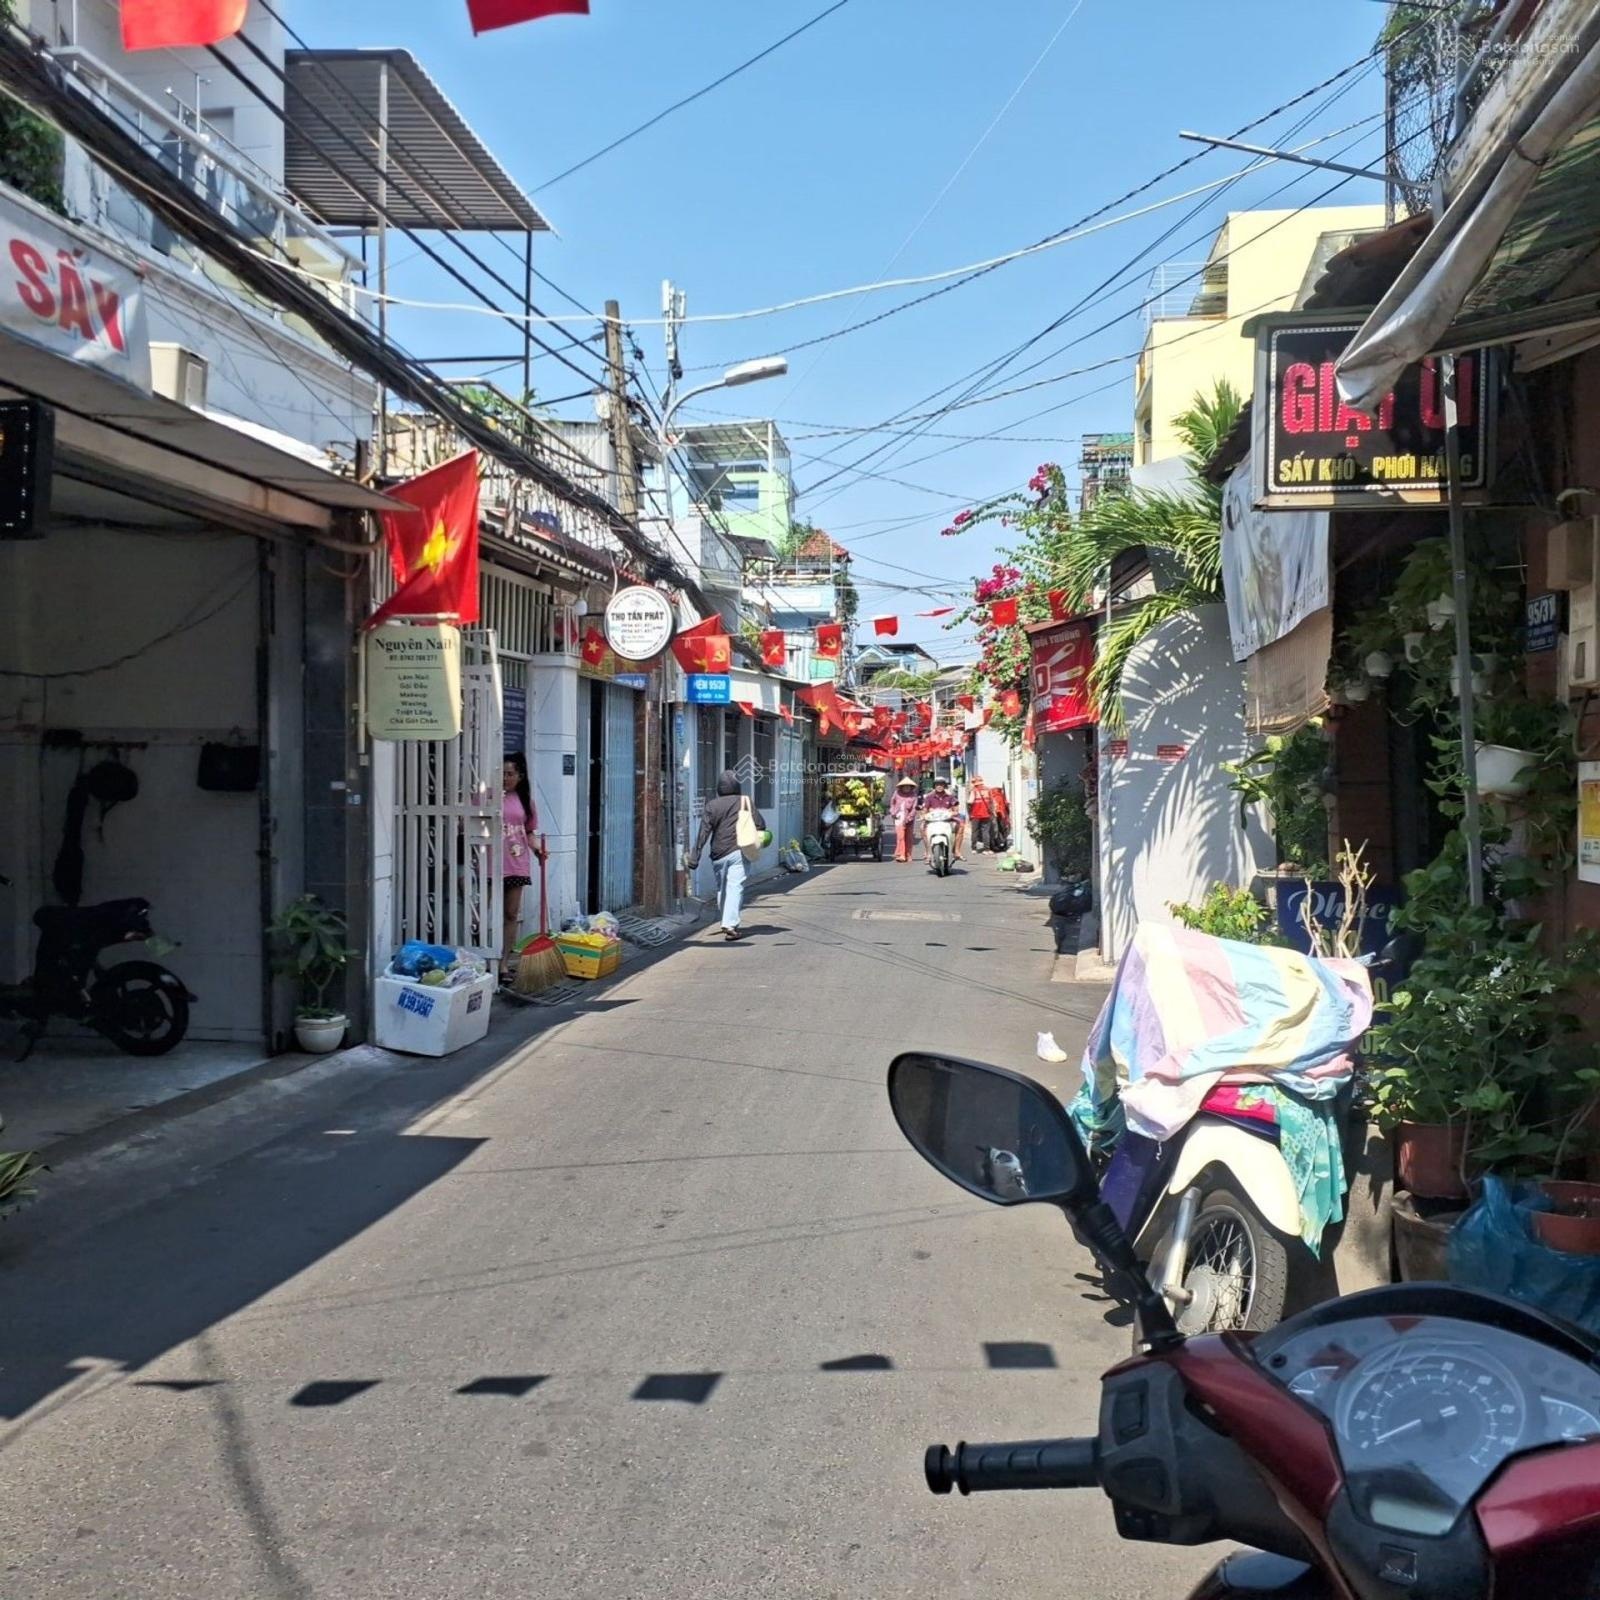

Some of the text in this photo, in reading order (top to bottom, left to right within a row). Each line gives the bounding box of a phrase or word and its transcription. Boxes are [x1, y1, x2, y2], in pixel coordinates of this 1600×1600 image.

[9, 238, 125, 353] SẤY
[1282, 361, 1395, 448] GI
[1279, 450, 1315, 483] SẤY
[1318, 452, 1356, 481] KHÔ
[1372, 453, 1416, 480] PHƠI
[1420, 446, 1473, 478] NẮG
[645, 610, 665, 621] PHÁT
[1287, 888, 1386, 923] Phc
